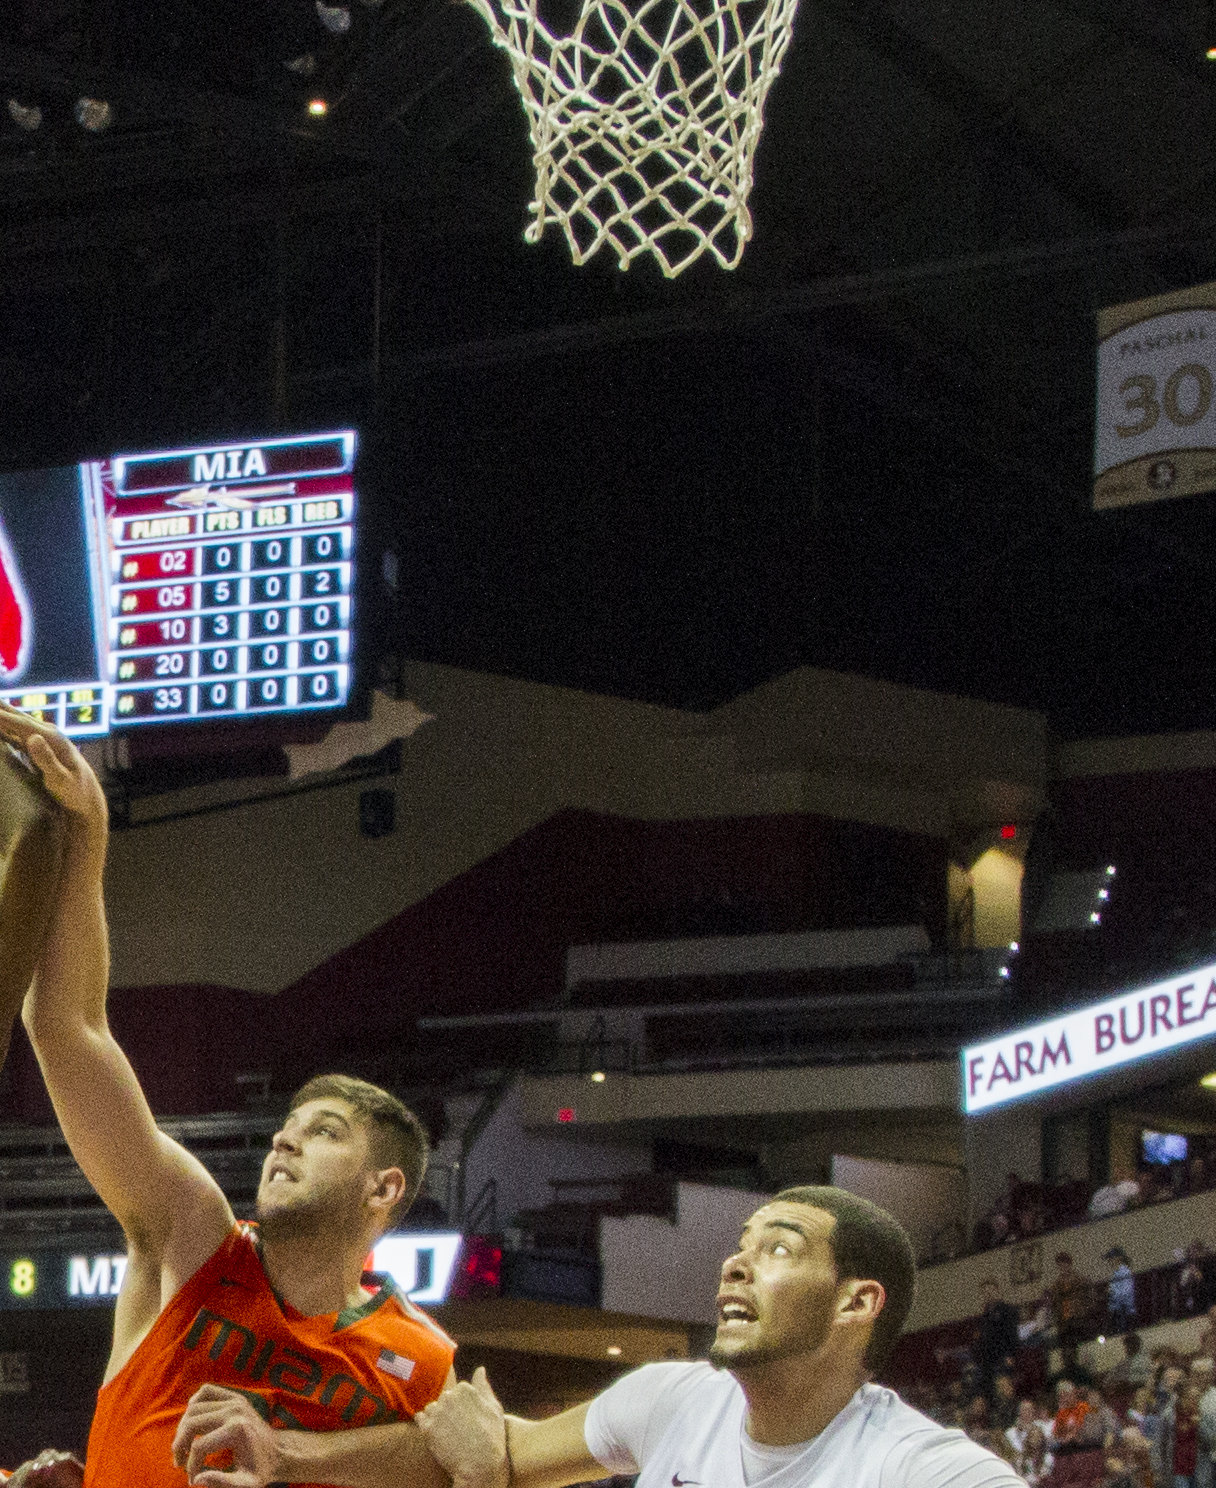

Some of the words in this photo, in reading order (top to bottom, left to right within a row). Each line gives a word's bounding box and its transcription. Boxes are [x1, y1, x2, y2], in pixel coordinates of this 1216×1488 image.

[1116, 363, 1213, 439] 30
[194, 448, 267, 482] MIA
[130, 517, 190, 539] PLAYER
[205, 511, 240, 531] PTS
[256, 506, 287, 527] FLS
[159, 551, 186, 572] 02
[216, 547, 231, 568] 0
[266, 541, 282, 562] 0
[316, 536, 333, 557] 0
[158, 586, 186, 607] 05
[214, 581, 230, 602] 5
[265, 576, 281, 597] 0
[315, 572, 331, 592] 2
[160, 618, 186, 640] 10
[214, 615, 229, 635] 3
[264, 610, 280, 631] 0
[313, 605, 330, 626] 0
[155, 653, 184, 675] 20
[212, 650, 228, 671] 0
[263, 645, 279, 666] 0
[313, 640, 329, 661] 0
[153, 688, 183, 709] 33
[211, 684, 227, 704] 0
[262, 679, 278, 700] 0
[312, 675, 328, 696] 0
[969, 1030, 1072, 1096] FARM
[10, 1258, 36, 1296] 8
